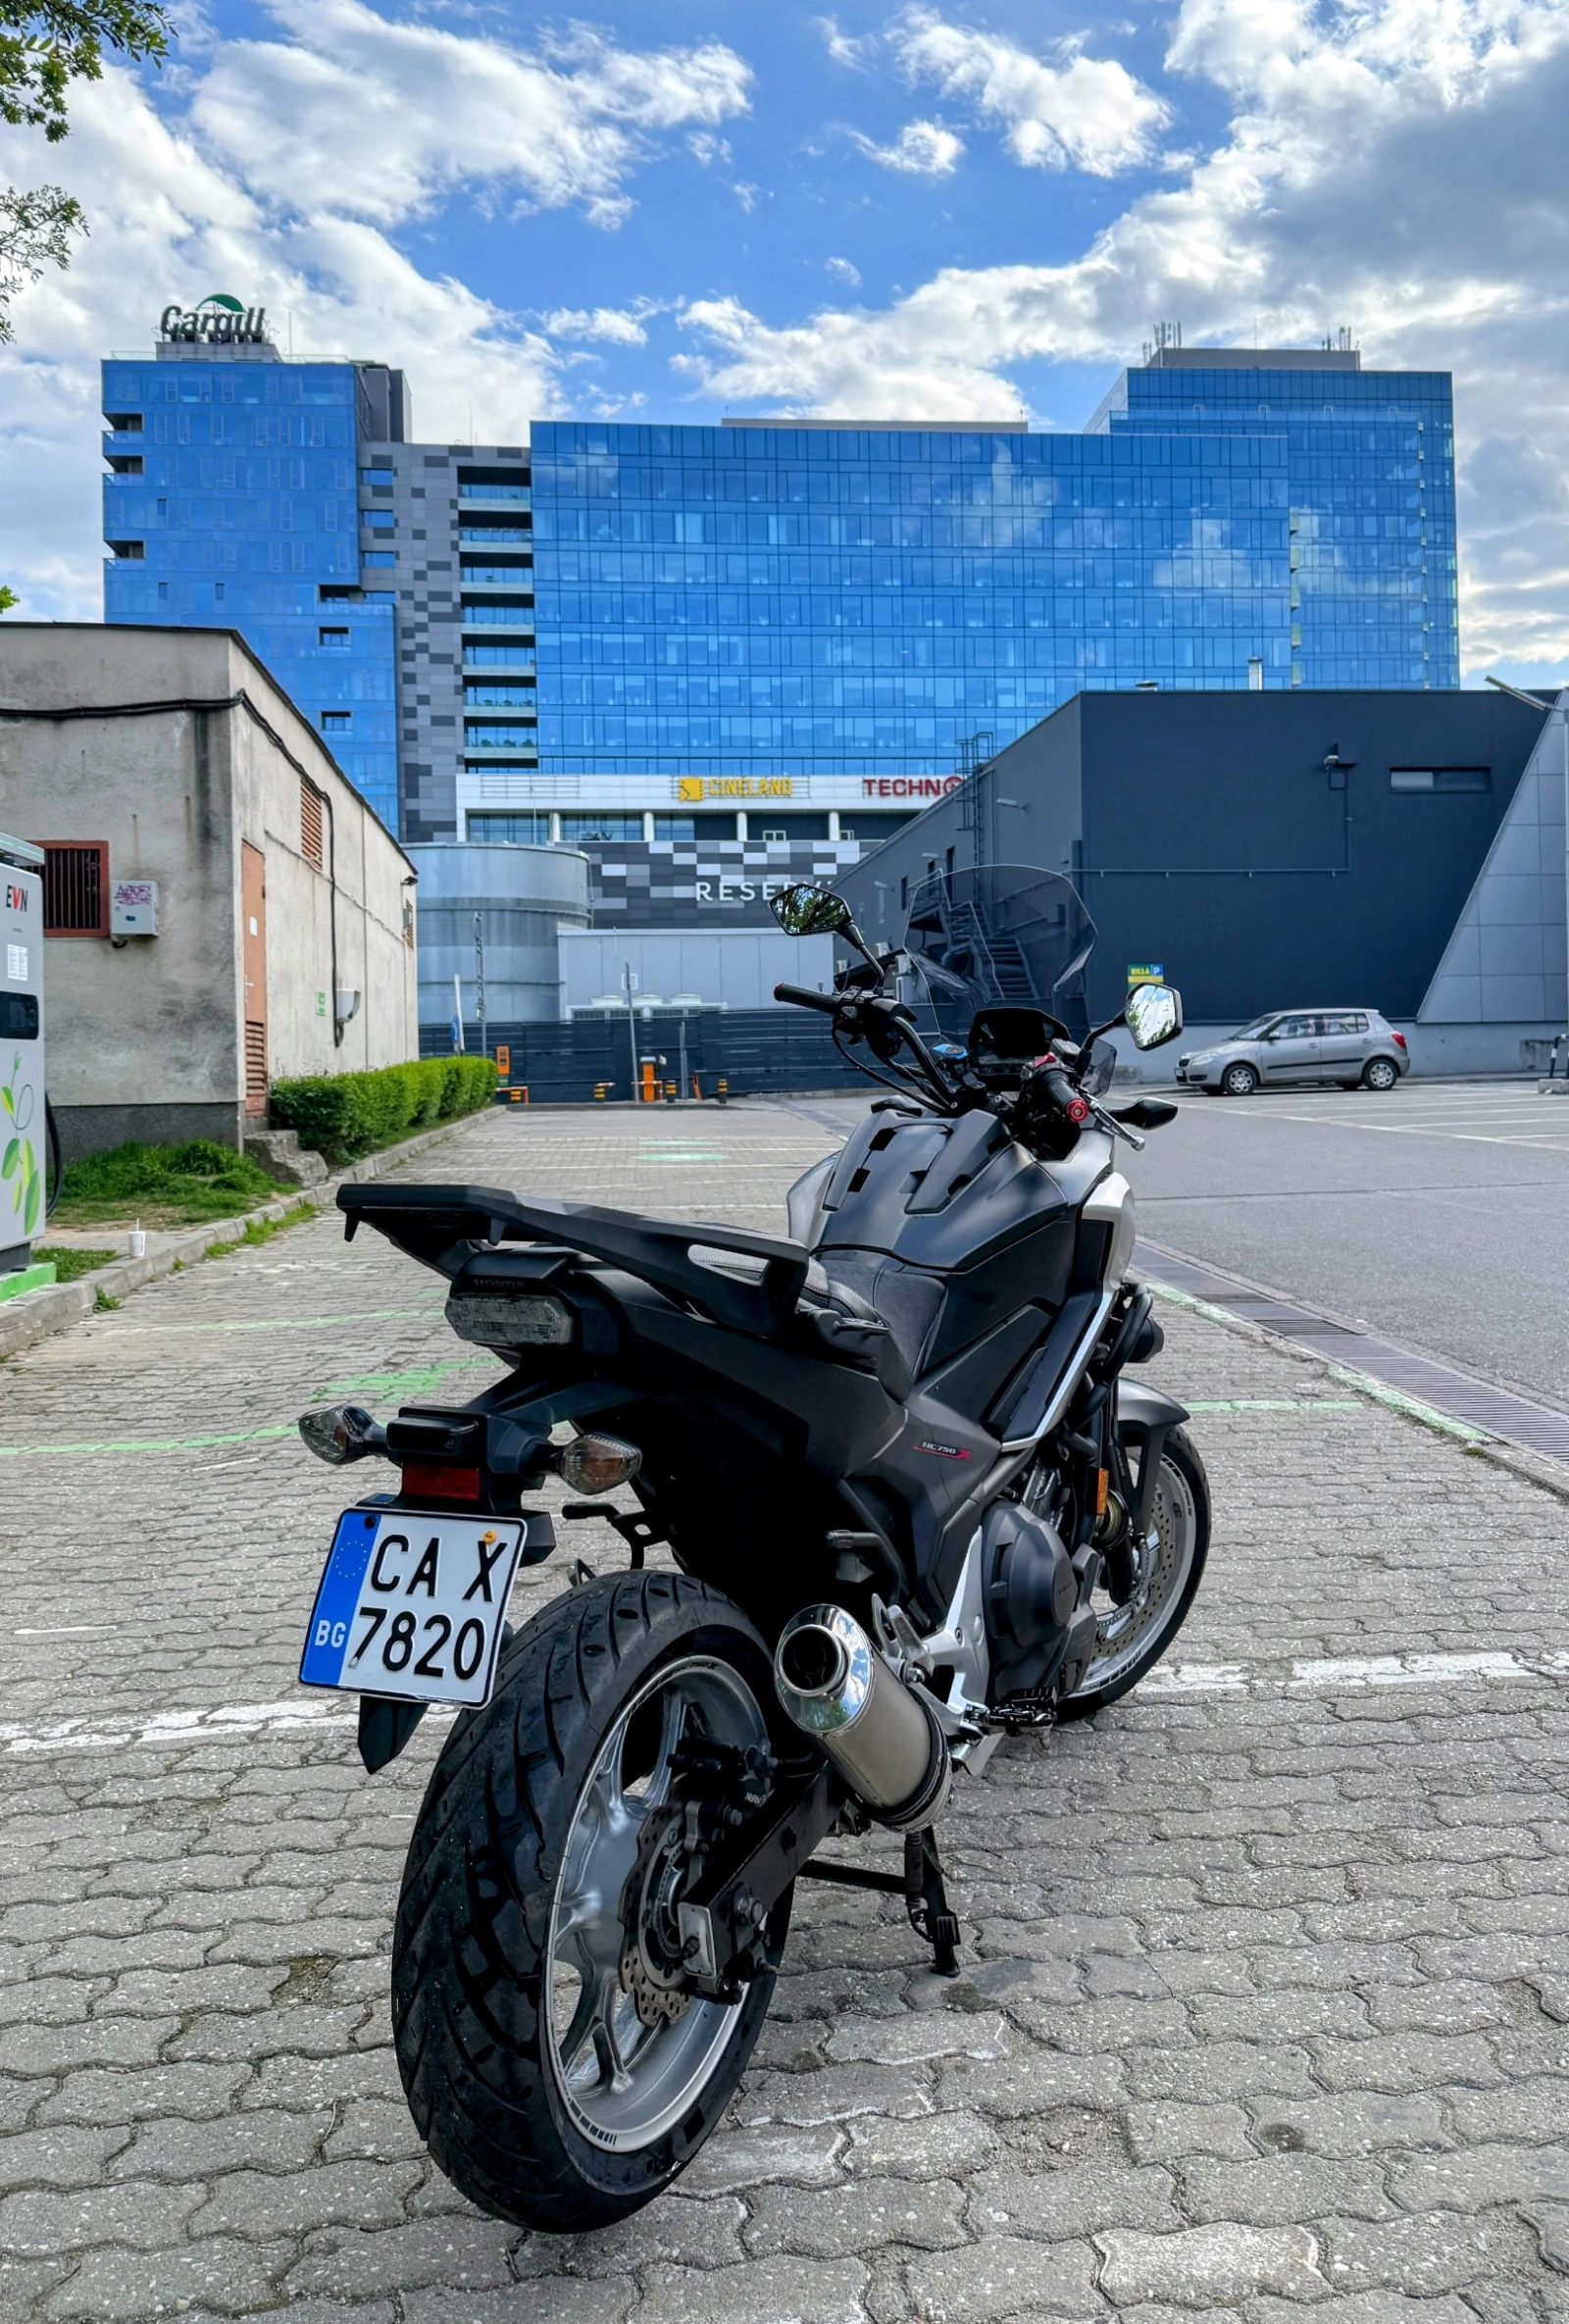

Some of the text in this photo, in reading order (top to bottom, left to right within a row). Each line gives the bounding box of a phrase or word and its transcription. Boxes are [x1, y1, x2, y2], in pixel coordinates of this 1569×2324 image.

[160, 305, 266, 341] Cargill
[708, 778, 793, 797] CINELAND
[6, 884, 28, 913] EVN
[695, 881, 832, 901] RESE
[1131, 967, 1150, 976] BILLA
[474, 1279, 527, 1288] HONDA
[371, 1534, 508, 1603] CA X
[315, 1619, 347, 1648] BG
[347, 1606, 487, 1681] 7820
